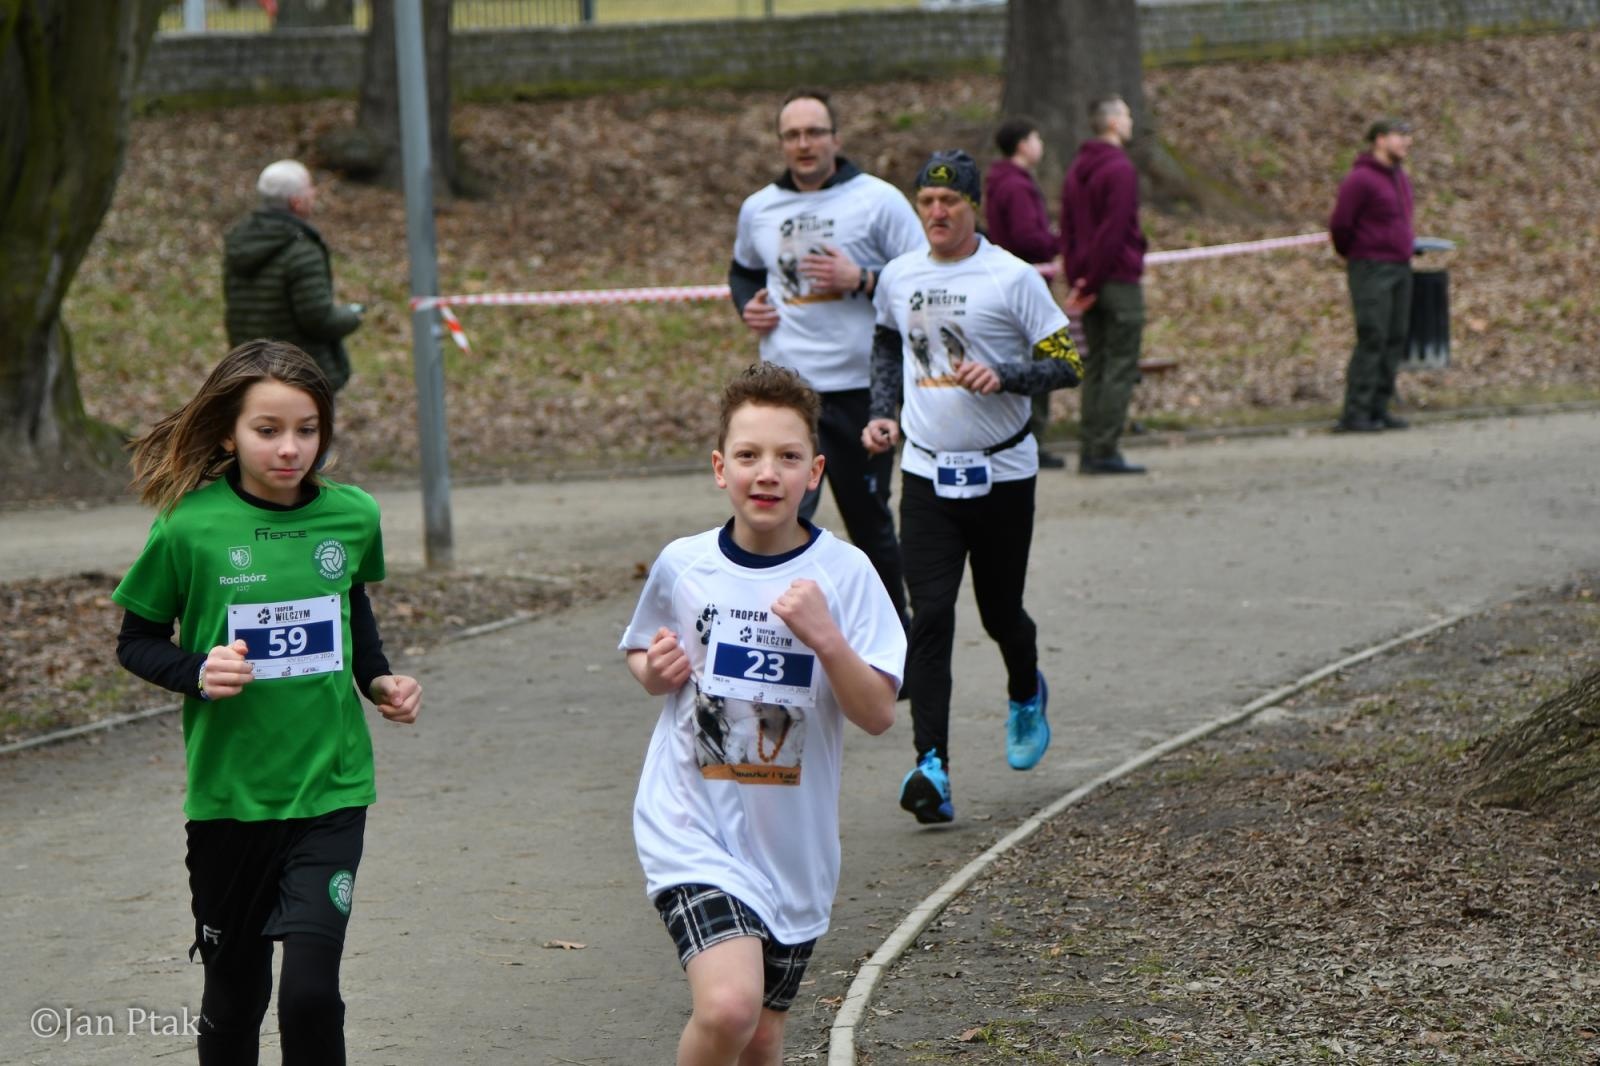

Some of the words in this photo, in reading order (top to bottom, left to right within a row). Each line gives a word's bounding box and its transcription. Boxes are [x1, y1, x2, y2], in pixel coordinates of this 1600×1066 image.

[955, 468, 968, 486] 5
[219, 572, 267, 585] Racibórz
[274, 605, 294, 613] TROPEM
[275, 609, 311, 621] WILCZYM
[730, 608, 768, 622] TROPEM
[756, 627, 776, 636] TROPEM
[268, 626, 308, 657] 59
[756, 634, 793, 647] WILCZYM
[743, 650, 785, 682] 23
